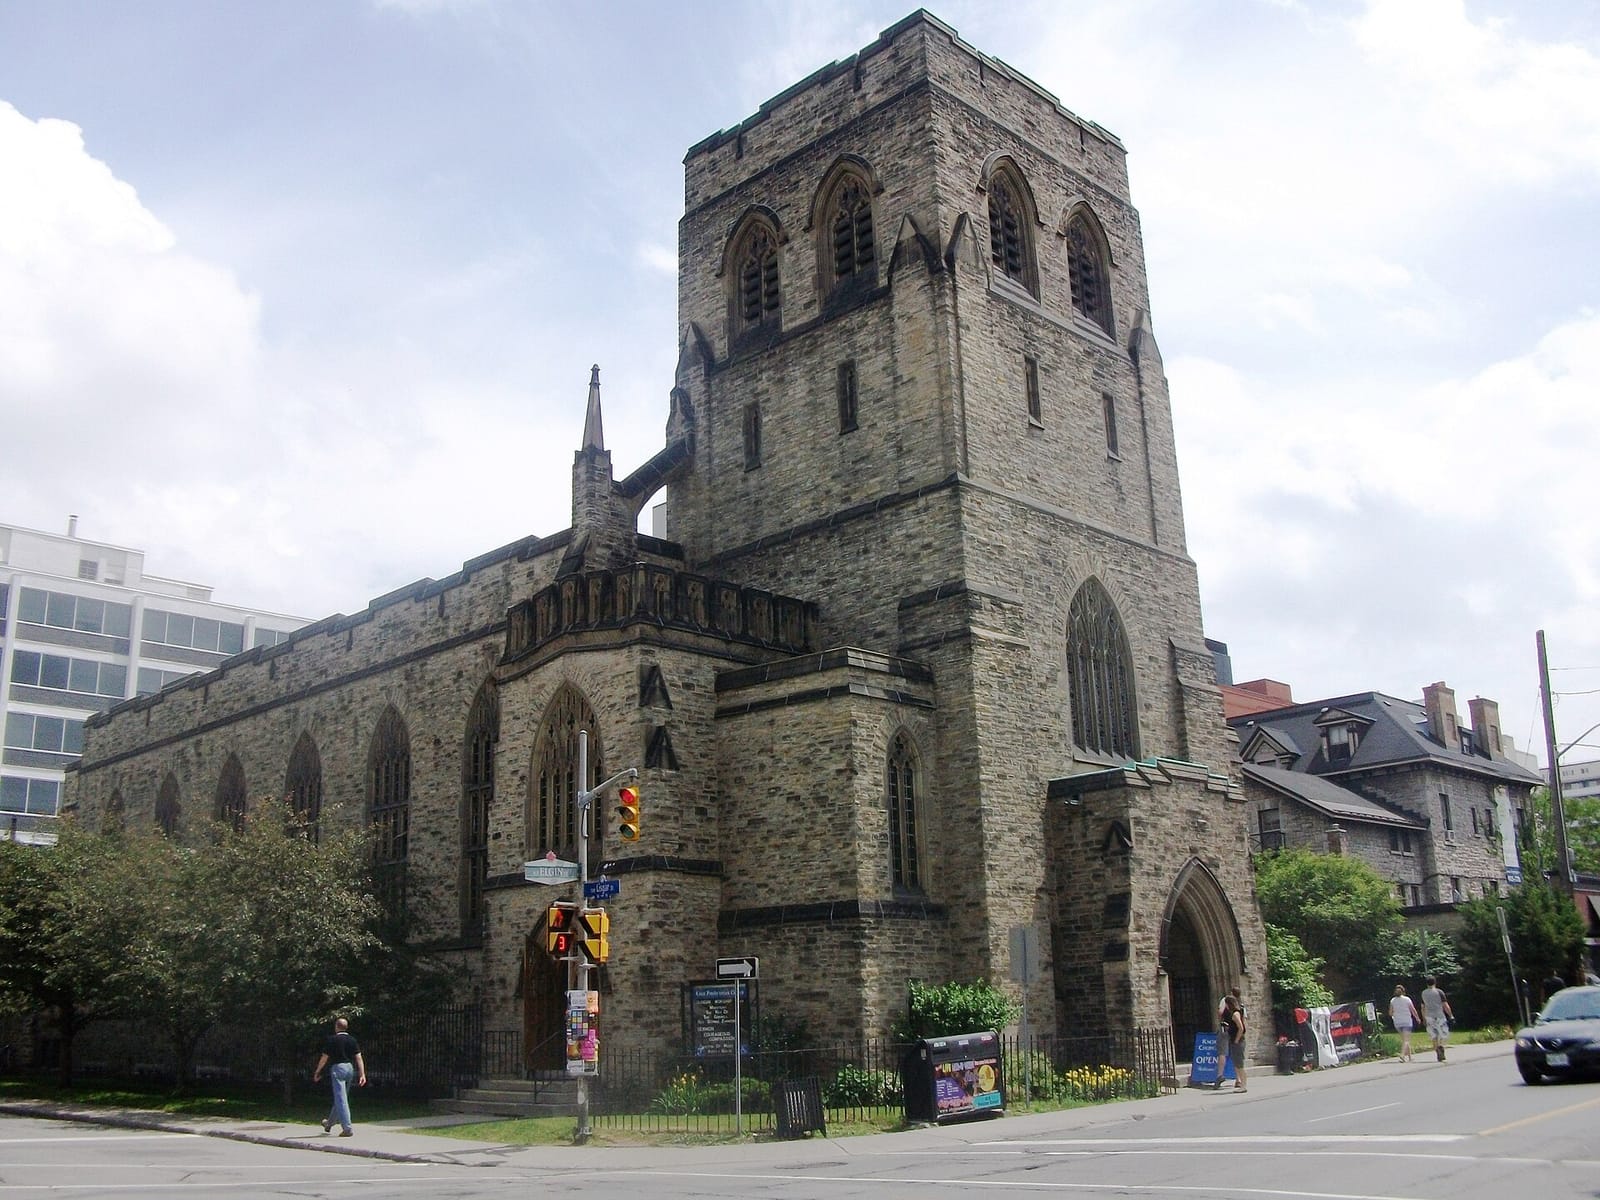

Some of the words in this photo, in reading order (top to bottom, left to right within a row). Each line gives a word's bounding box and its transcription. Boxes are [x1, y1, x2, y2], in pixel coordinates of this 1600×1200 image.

[540, 868, 563, 877] ELGIN
[559, 936, 565, 950] 3
[1196, 1056, 1219, 1064] OPEN
